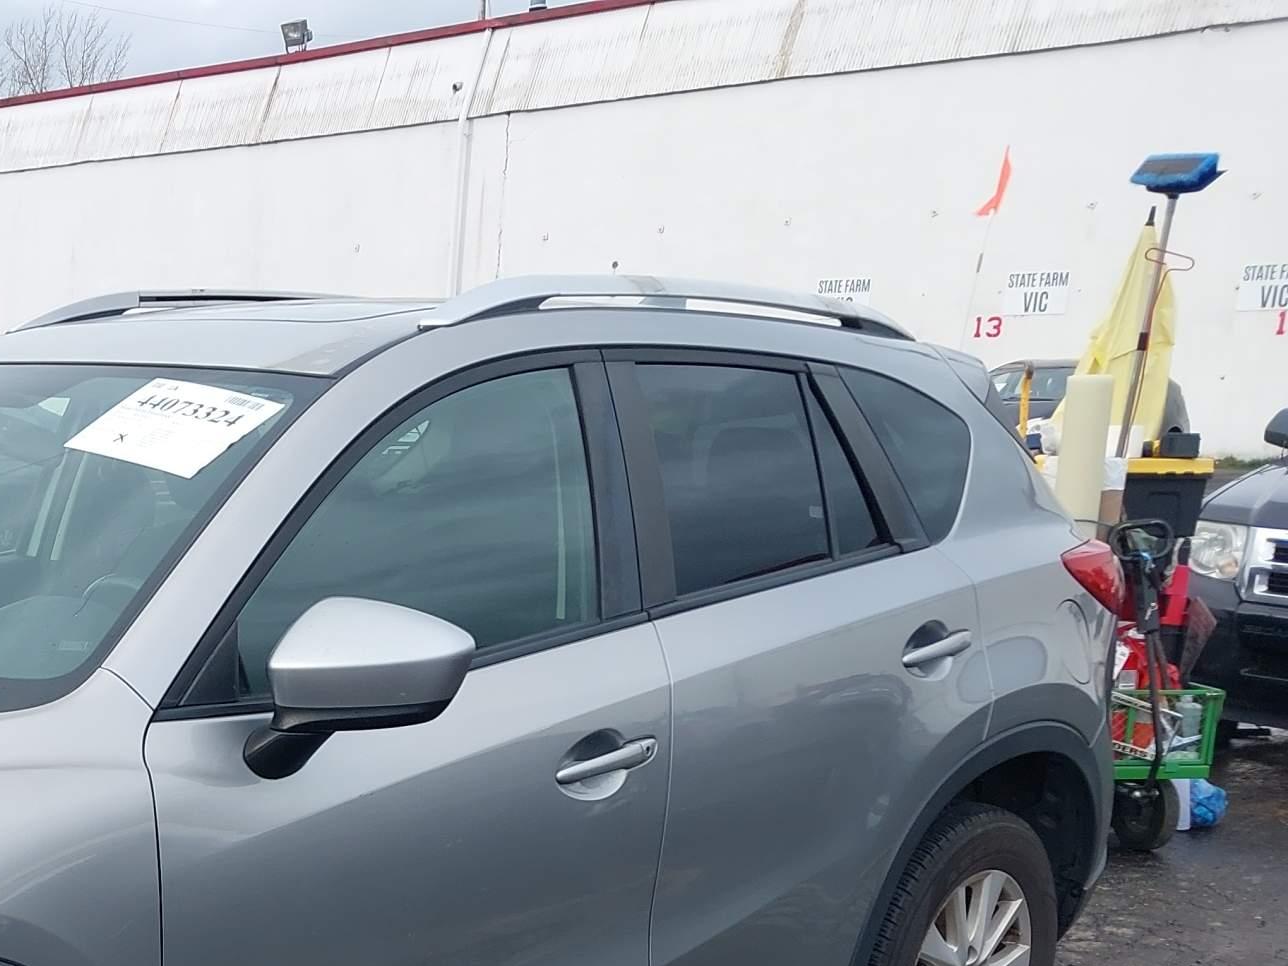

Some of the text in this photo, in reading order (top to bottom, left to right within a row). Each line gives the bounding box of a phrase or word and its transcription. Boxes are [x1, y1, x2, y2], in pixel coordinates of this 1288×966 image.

[1008, 272, 1070, 288] STATE FARM
[1242, 264, 1278, 281] STATE
[817, 278, 871, 294] STATE FARM
[1260, 284, 1288, 308] VIC
[1023, 291, 1049, 313] VIC
[973, 316, 1003, 338] 13
[137, 394, 245, 427] 44073324
